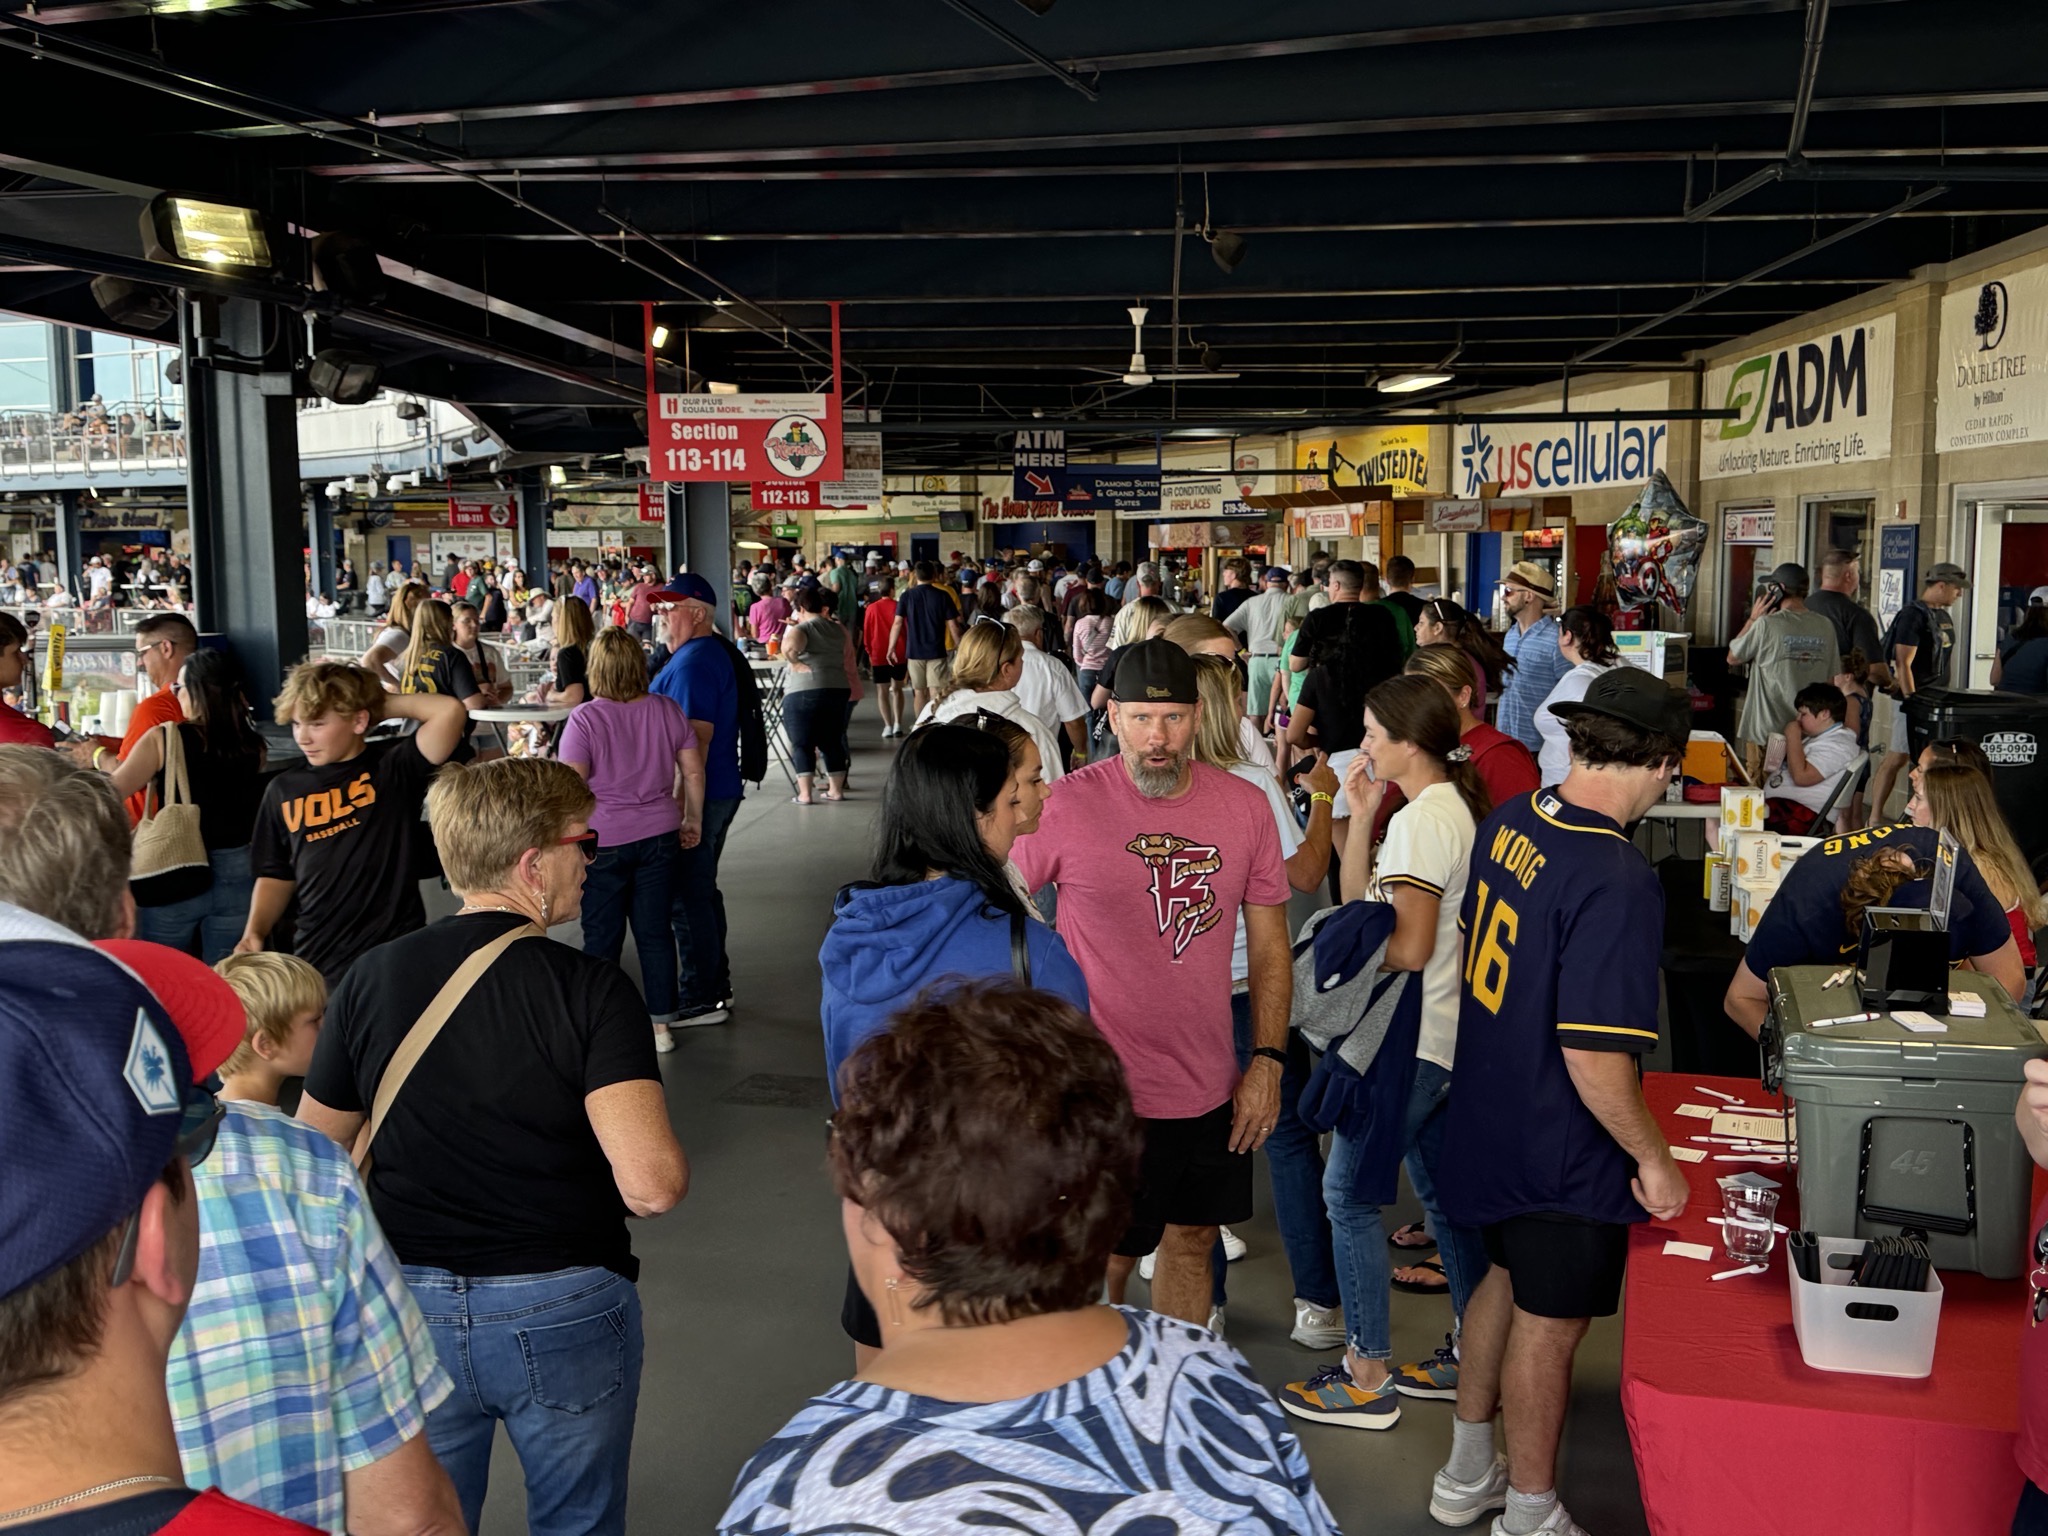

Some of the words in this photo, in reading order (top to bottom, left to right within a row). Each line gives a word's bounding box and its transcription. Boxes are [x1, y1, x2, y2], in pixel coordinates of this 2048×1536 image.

[1765, 327, 1867, 433] ADM
[682, 406, 715, 414] EQUALS
[1974, 392, 1982, 410] by
[1982, 390, 2004, 405] Hilton
[671, 422, 738, 440] Section
[1965, 417, 1987, 431] CEDAR
[1989, 413, 2013, 428] RAPIDS
[1015, 430, 1064, 449] ATM
[1950, 431, 1994, 447] CONVENTION
[1996, 427, 2029, 442] COMPLEX
[665, 448, 746, 471] 113-114
[1015, 453, 1065, 467] HERE
[1719, 449, 1757, 473] Unlocking
[1759, 448, 1792, 468] Nature.
[1795, 438, 1841, 464] Enriching
[1843, 432, 1866, 457] Life.
[1356, 449, 1407, 486] TWISTED
[761, 490, 809, 504] 112-113
[1162, 486, 1173, 497] AIR
[1174, 484, 1222, 496] CONDITIONING
[982, 499, 998, 520] The
[1170, 499, 1210, 511] FIREPLACES
[1991, 733, 2028, 743] ABC
[1982, 744, 2035, 753] 395-0904
[281, 772, 376, 833] VOLS
[305, 817, 361, 843] BASEBALL
[1490, 824, 1547, 890] WONG
[1465, 879, 1519, 1016] 16
[1890, 1150, 1937, 1175] 45
